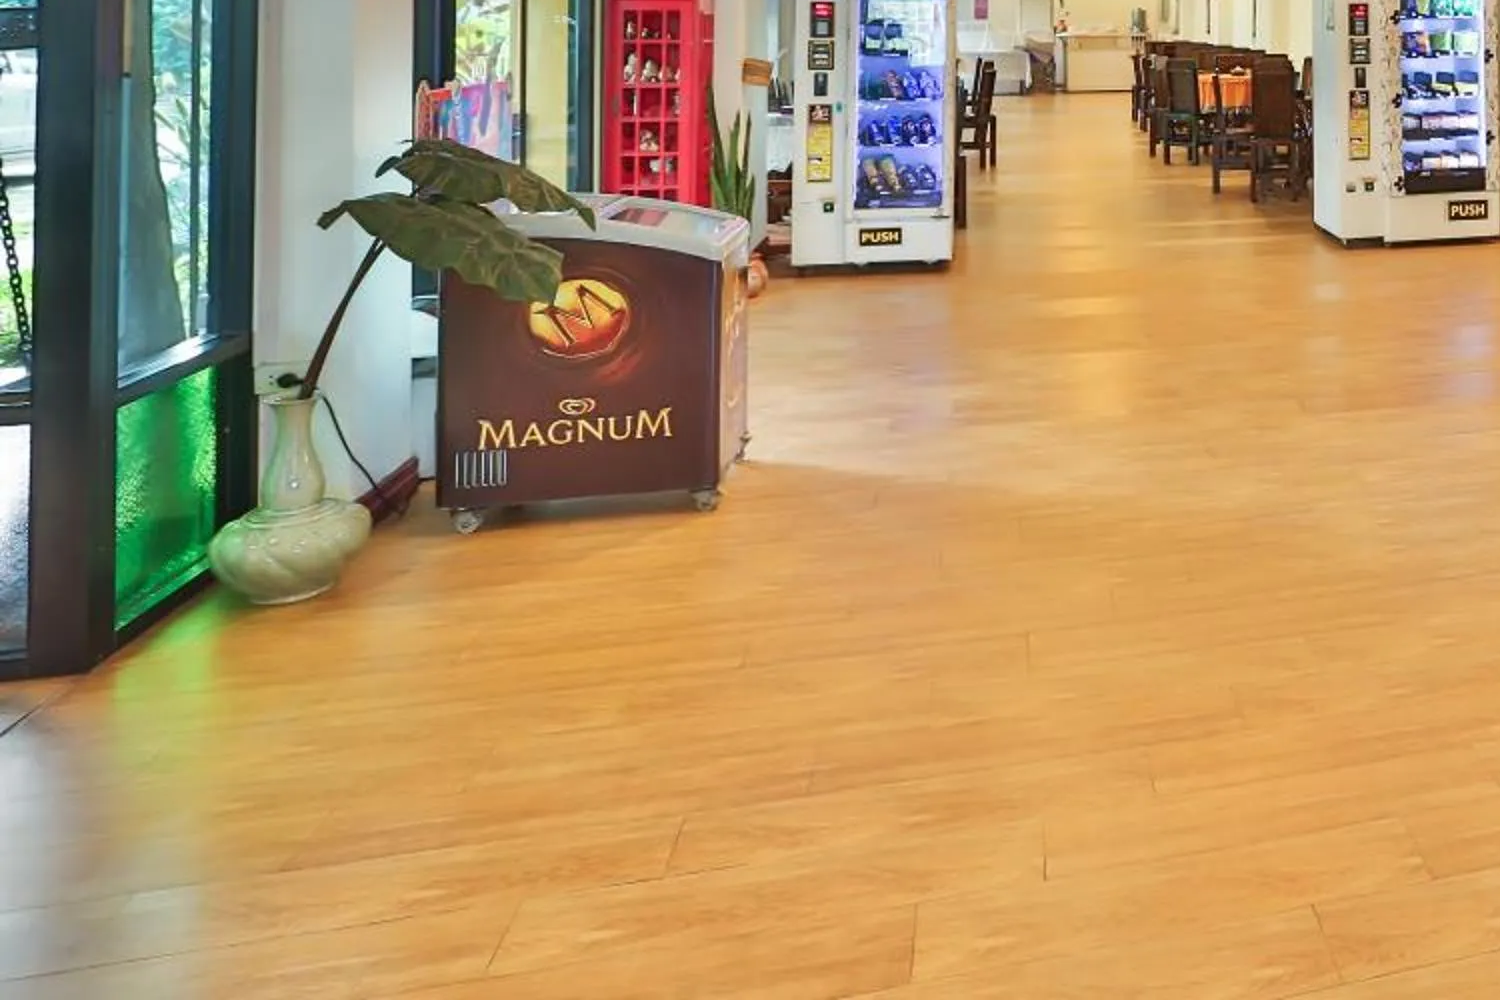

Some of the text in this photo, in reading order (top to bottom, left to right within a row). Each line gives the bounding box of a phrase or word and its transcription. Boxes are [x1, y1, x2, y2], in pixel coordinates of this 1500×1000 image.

[1451, 203, 1485, 217] PUSH
[861, 231, 900, 243] PUSH
[533, 283, 624, 347] M
